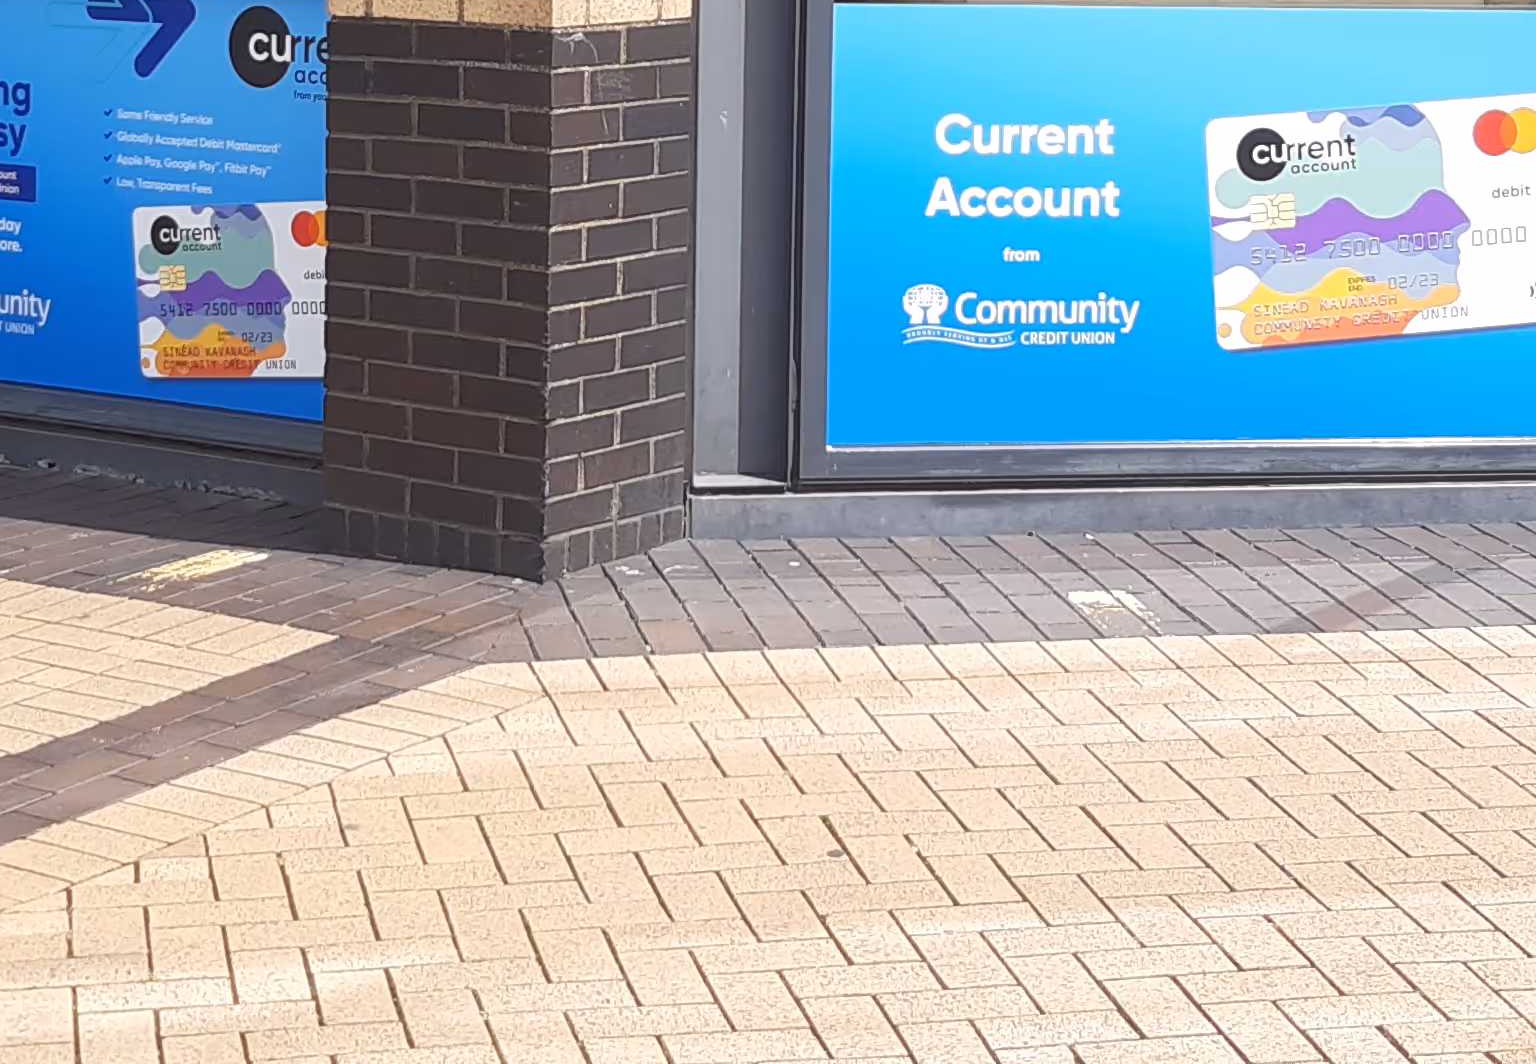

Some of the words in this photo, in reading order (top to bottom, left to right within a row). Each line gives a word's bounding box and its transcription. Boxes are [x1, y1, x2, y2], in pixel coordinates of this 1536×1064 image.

[935, 113, 1115, 155] Current
[1251, 134, 1356, 166] current
[1290, 158, 1357, 175] account
[924, 176, 1120, 218] Account
[1491, 184, 1532, 199] debit
[159, 224, 222, 242] current
[182, 242, 223, 252] account
[1002, 246, 1041, 262] from
[1250, 242, 1307, 266] 5412
[1324, 237, 1381, 261] 7500
[1397, 230, 1455, 254] 0000
[1471, 225, 1528, 247] 0000
[1387, 273, 1440, 290] 02/23
[1319, 294, 1398, 312] KAVANAGH
[955, 291, 1141, 334] Community
[1253, 315, 1342, 336] COMMUNITY
[1352, 310, 1410, 327] CREDIT
[1420, 304, 1469, 321] UNION
[5, 321, 35, 335] UNION
[1020, 331, 1069, 345] CREDIT
[1071, 331, 1116, 345] UNION
